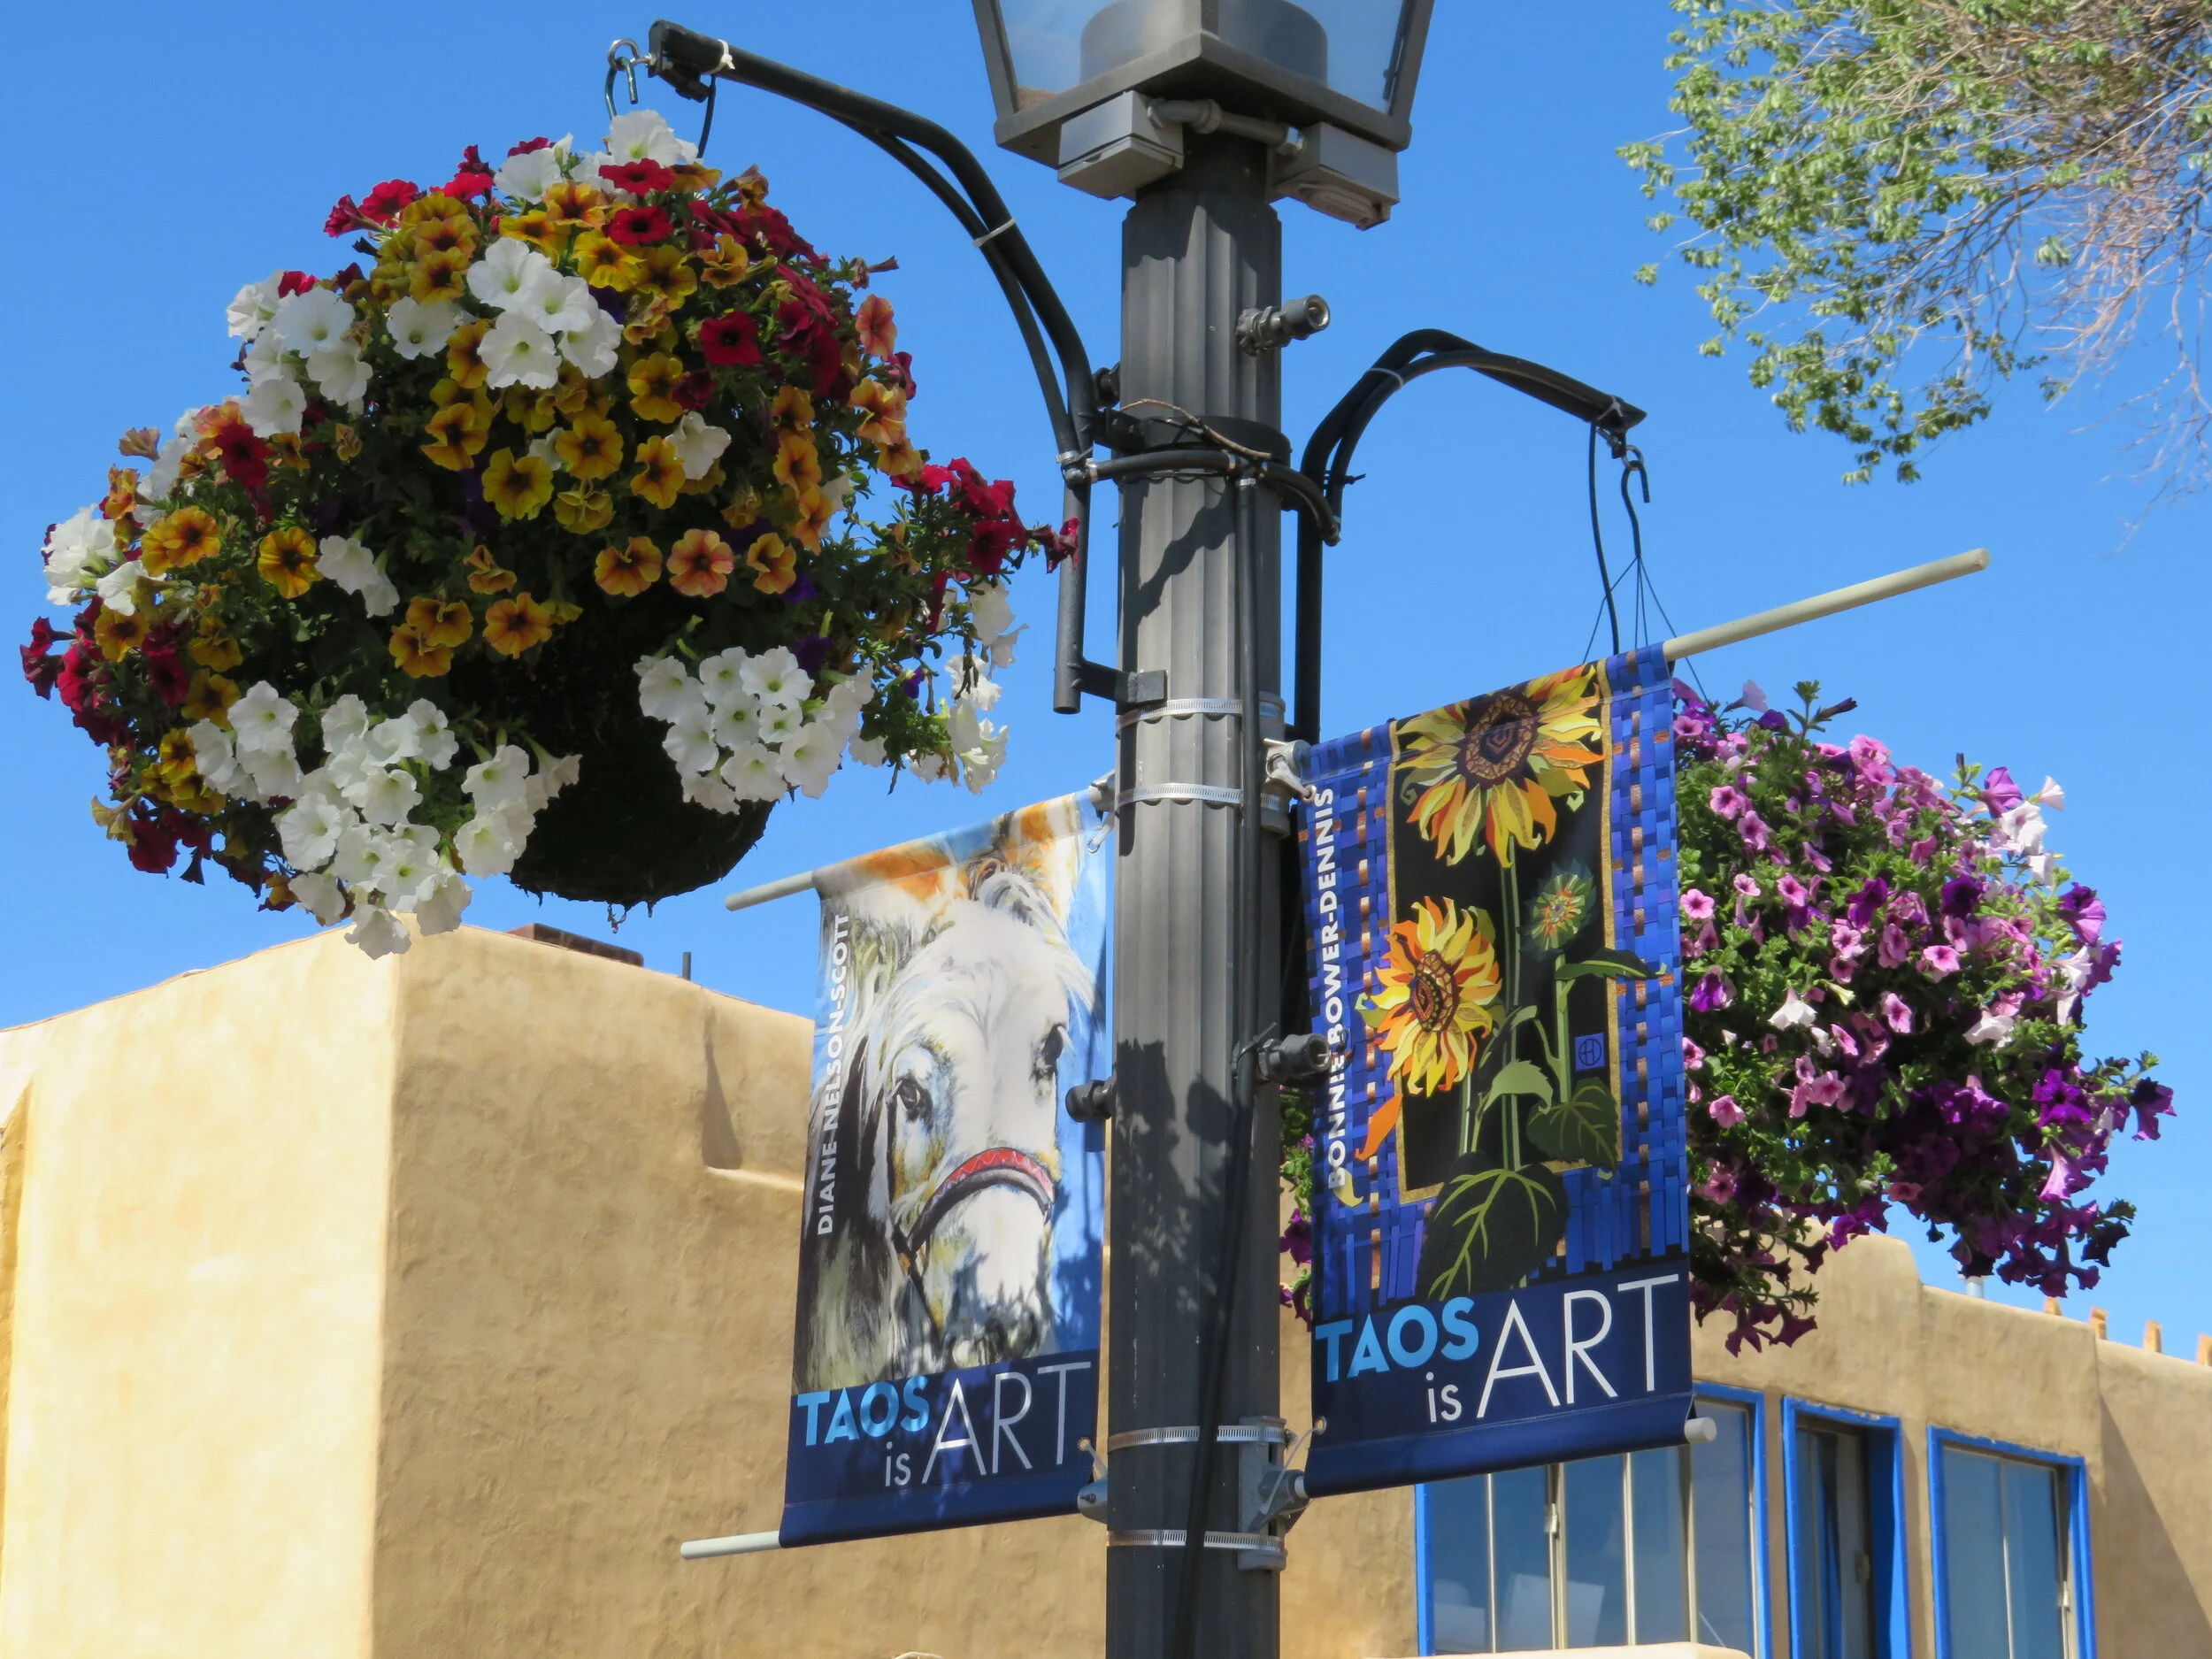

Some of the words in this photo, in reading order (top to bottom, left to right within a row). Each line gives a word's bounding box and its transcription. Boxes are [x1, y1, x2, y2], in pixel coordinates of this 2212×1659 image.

[1314, 788, 1343, 1045] BOWER-DENNIS
[824, 915, 850, 1131] NELSON-SCOTT
[818, 1141, 838, 1235] DIANE
[1328, 1053, 1346, 1189] BONNIE
[1315, 1296, 1479, 1382] TAOS
[1425, 1372, 1462, 1423] is
[1476, 1274, 1678, 1419] ART
[797, 1376, 930, 1447] TAOS
[885, 1441, 911, 1487] is
[921, 1362, 1092, 1485] ART
